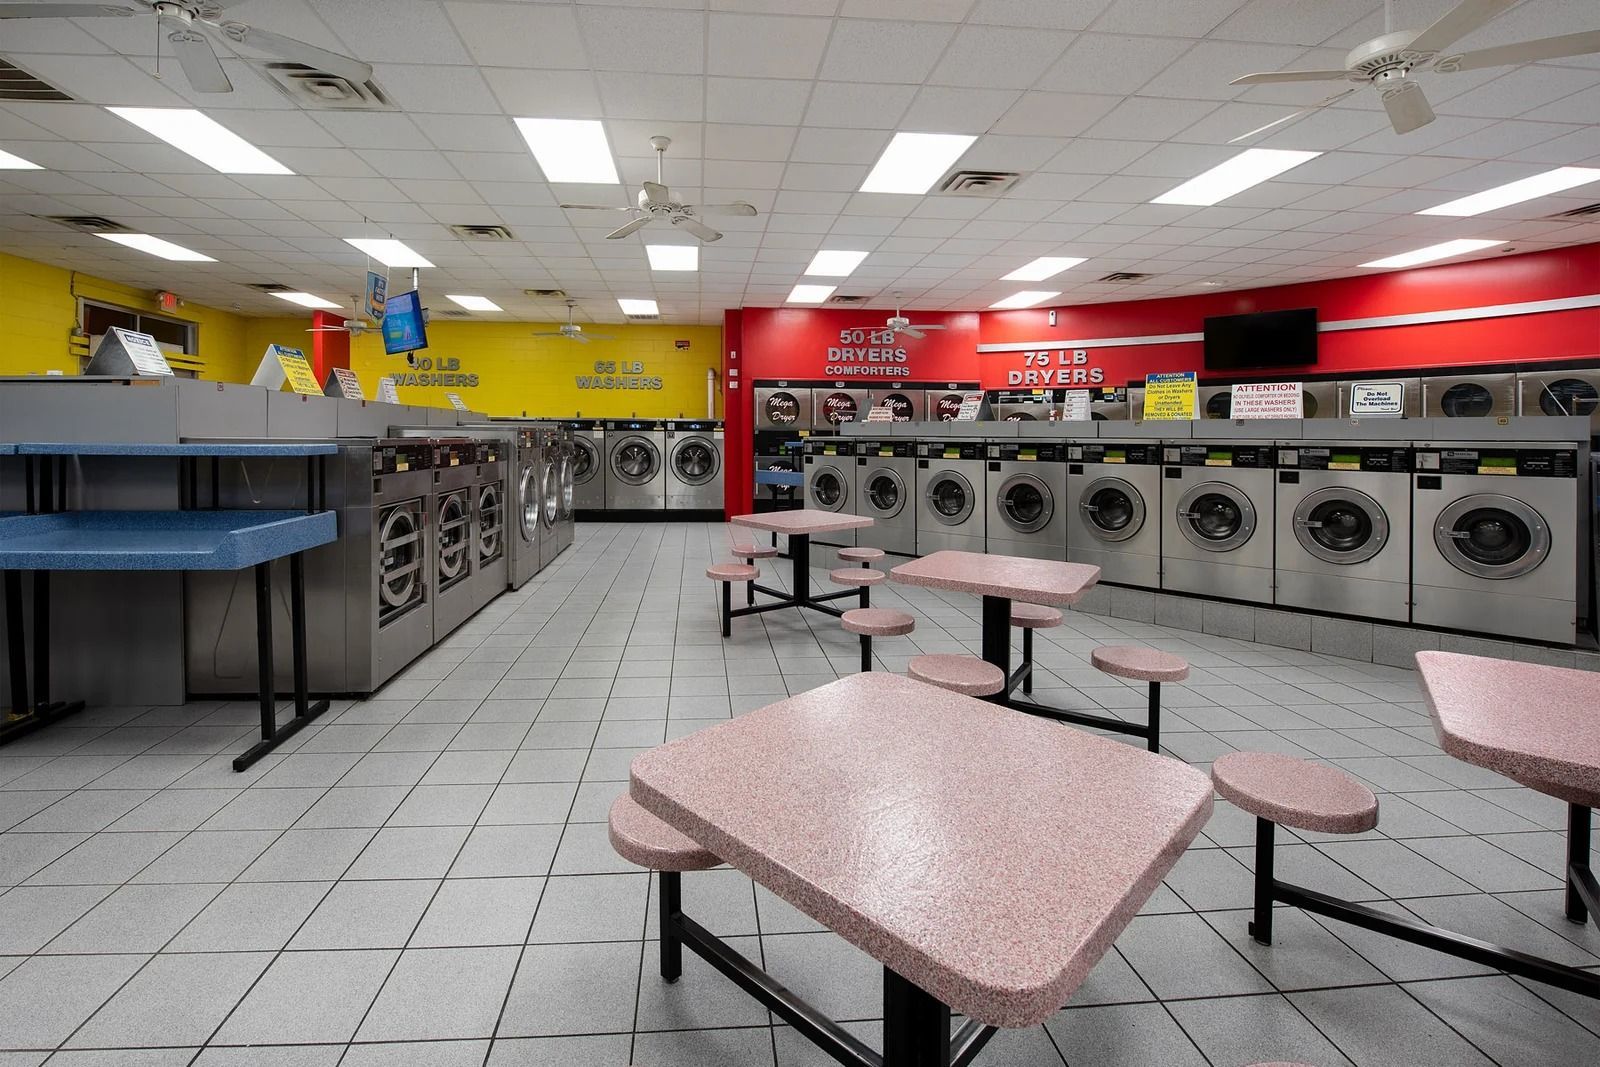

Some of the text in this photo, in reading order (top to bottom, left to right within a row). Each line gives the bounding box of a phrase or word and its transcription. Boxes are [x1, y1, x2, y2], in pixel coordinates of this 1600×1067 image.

[840, 329, 895, 344] 50 LB
[827, 347, 907, 362] DRYERS
[1024, 350, 1087, 367] 75 LB
[436, 357, 460, 371] LB
[595, 360, 644, 374] 65 LB
[825, 365, 910, 376] COMFORTERS
[389, 373, 479, 387] WASHERS
[575, 375, 663, 390] WASHERS
[1008, 368, 1104, 385] DRYERS
[1237, 384, 1296, 392] ATTENTION
[769, 397, 793, 408] Mega
[827, 398, 851, 409] Mega
[884, 398, 907, 410] Mega
[772, 411, 796, 423] Dryer
[830, 412, 853, 423] Dryer
